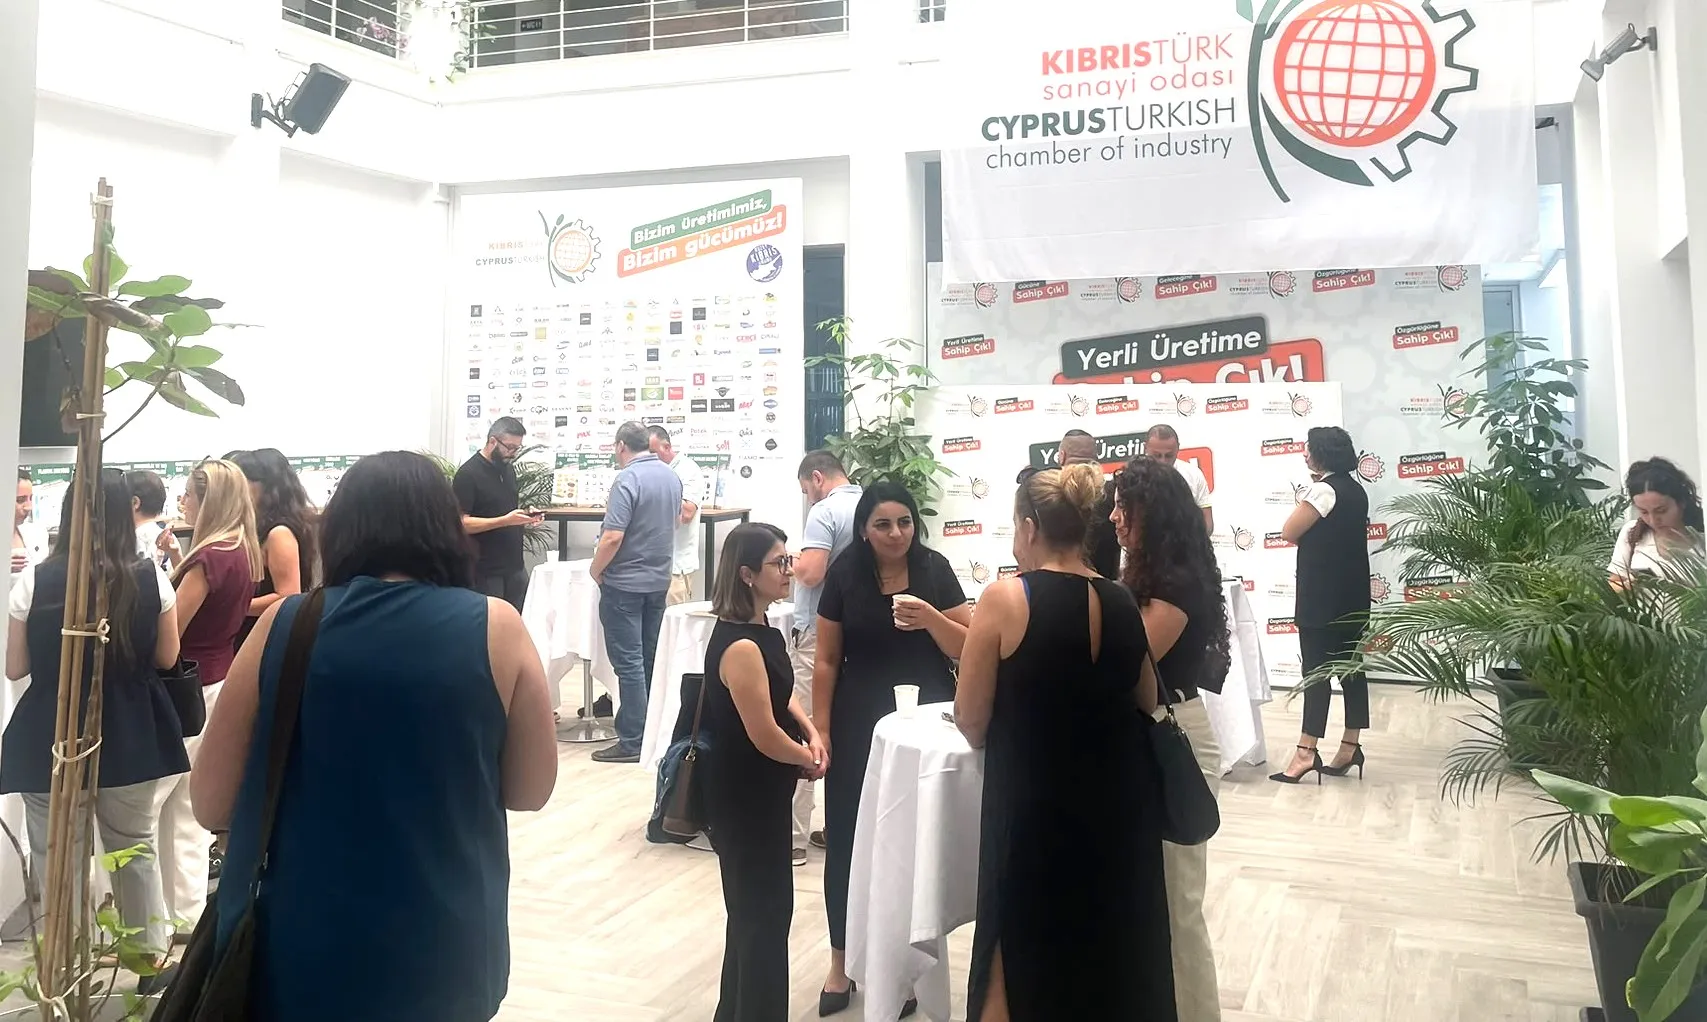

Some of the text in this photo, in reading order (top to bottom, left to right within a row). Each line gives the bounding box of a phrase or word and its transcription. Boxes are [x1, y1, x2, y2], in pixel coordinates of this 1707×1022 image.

[1041, 32, 1234, 76] KIBRISTÜRK
[1043, 63, 1234, 101] sanayi odası
[981, 97, 1236, 142] CYPRUSTURKISH
[986, 132, 1233, 170] chamber of industry
[634, 222, 676, 244] Bizim
[623, 245, 677, 272] Bizim
[1159, 279, 1213, 295] Sahip Çık!
[1316, 272, 1371, 289] Sahip Çık!
[1016, 285, 1065, 300] Sahip Çık!
[1396, 330, 1454, 344] Sahip Çık!
[944, 341, 991, 356] Sahip Çık!
[1077, 330, 1262, 371] Yerli Üretime
[1095, 438, 1148, 459] Üreti
[1402, 460, 1459, 475] Sahip Çık!
